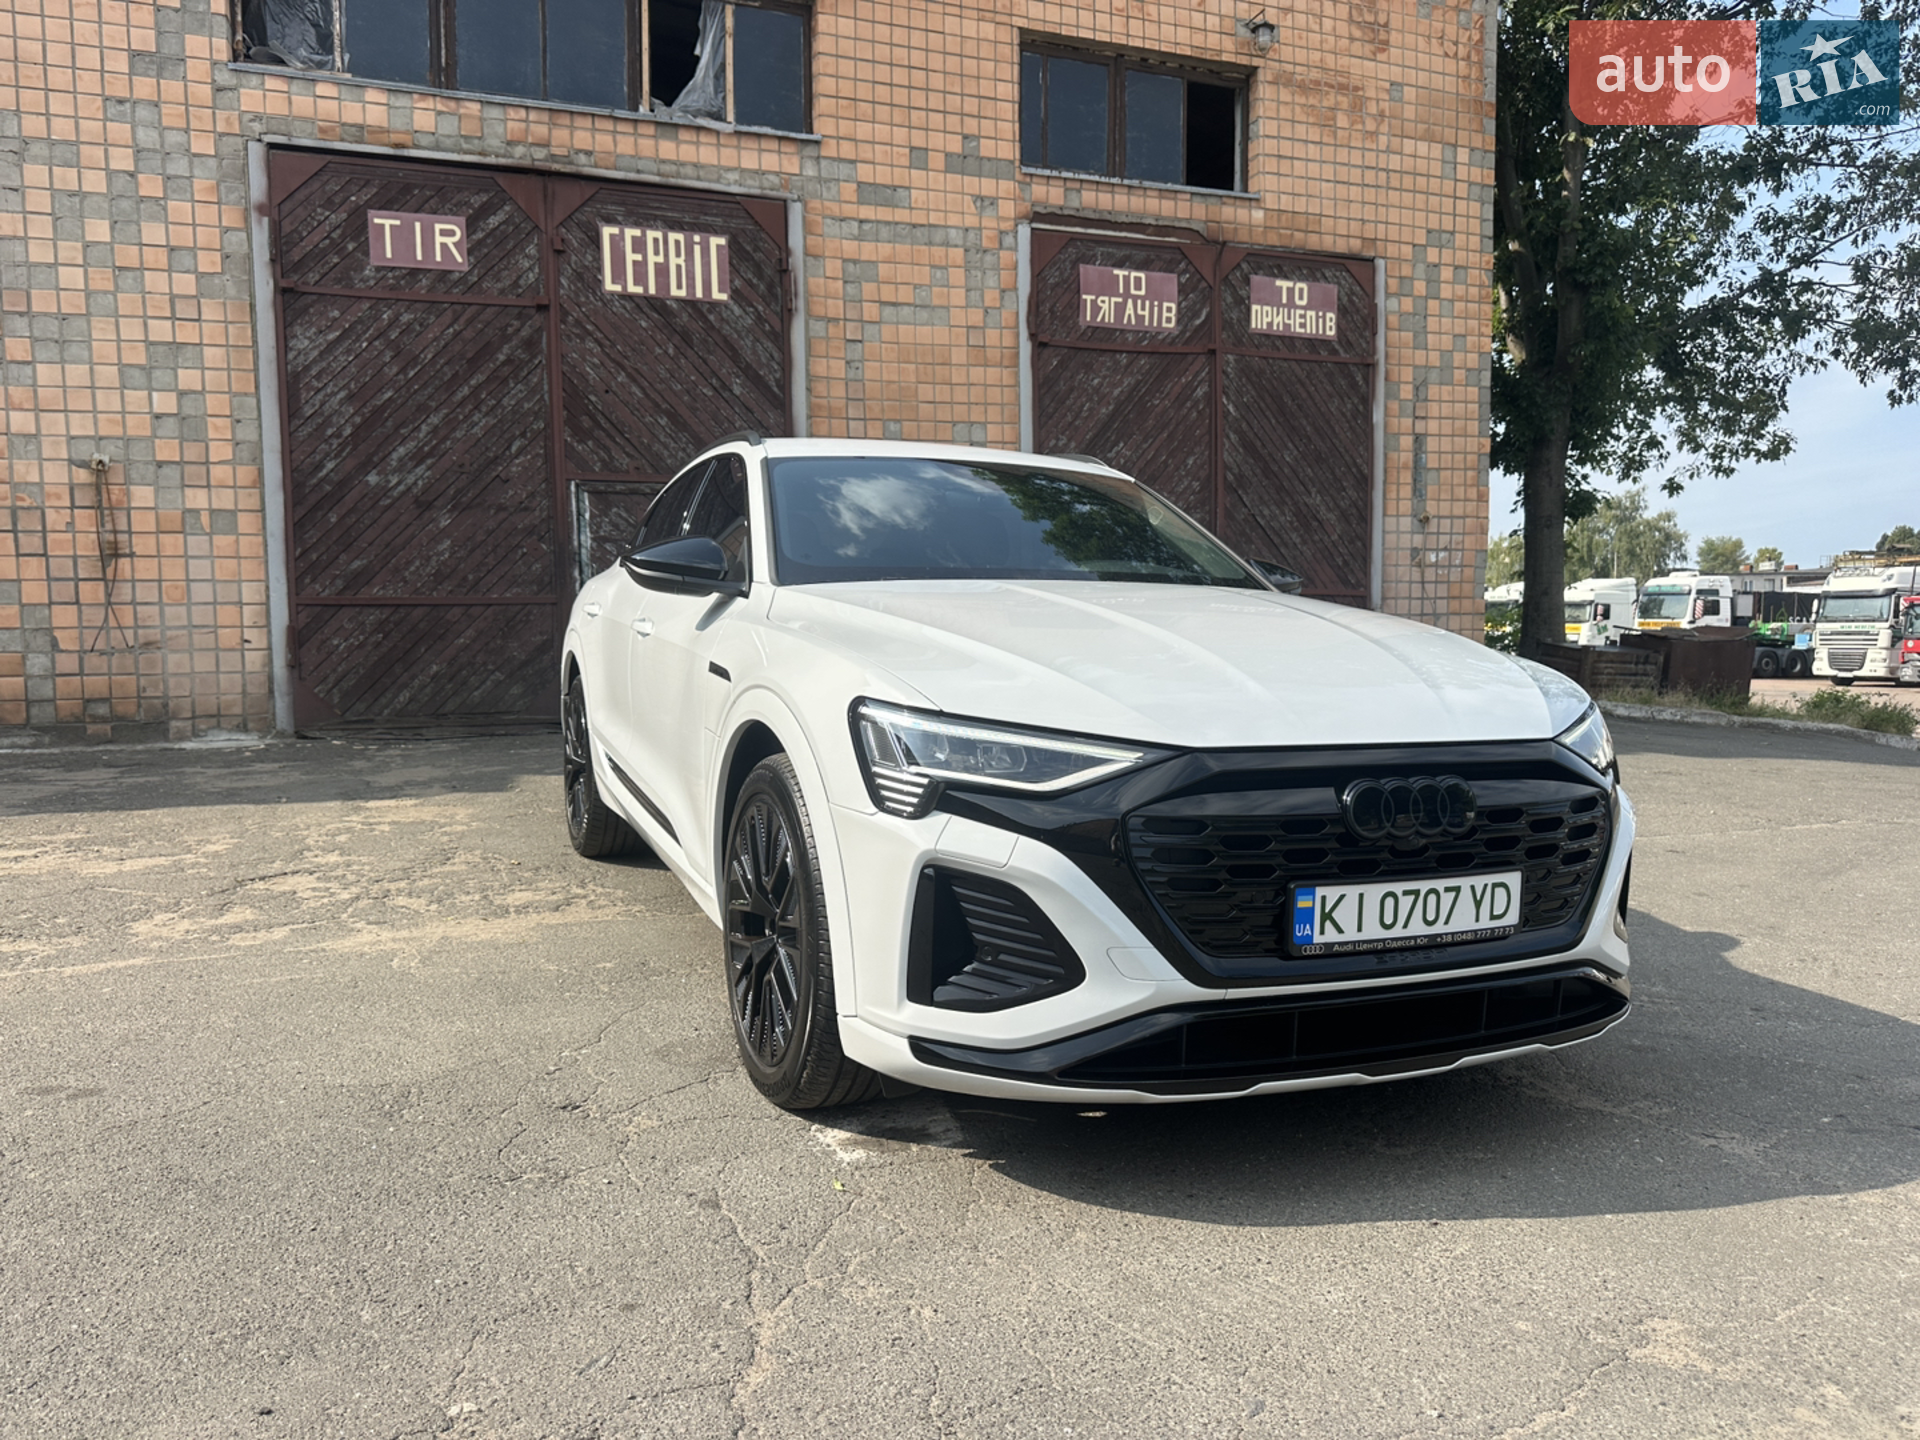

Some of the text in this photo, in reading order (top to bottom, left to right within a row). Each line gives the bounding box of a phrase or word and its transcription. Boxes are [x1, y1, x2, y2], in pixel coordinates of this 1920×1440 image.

[373, 217, 463, 263] TIR
[1113, 269, 1146, 296] ТО
[1275, 280, 1308, 306] ТО
[1319, 881, 1512, 936] KI 0707 YD
[1296, 924, 1312, 937] UA
[1332, 942, 1354, 952] Audi
[1356, 941, 1383, 951] Центр
[1385, 939, 1415, 948] Одесса
[1436, 934, 1452, 943] +38
[1454, 932, 1475, 942] (048)
[1476, 930, 1491, 938] 777
